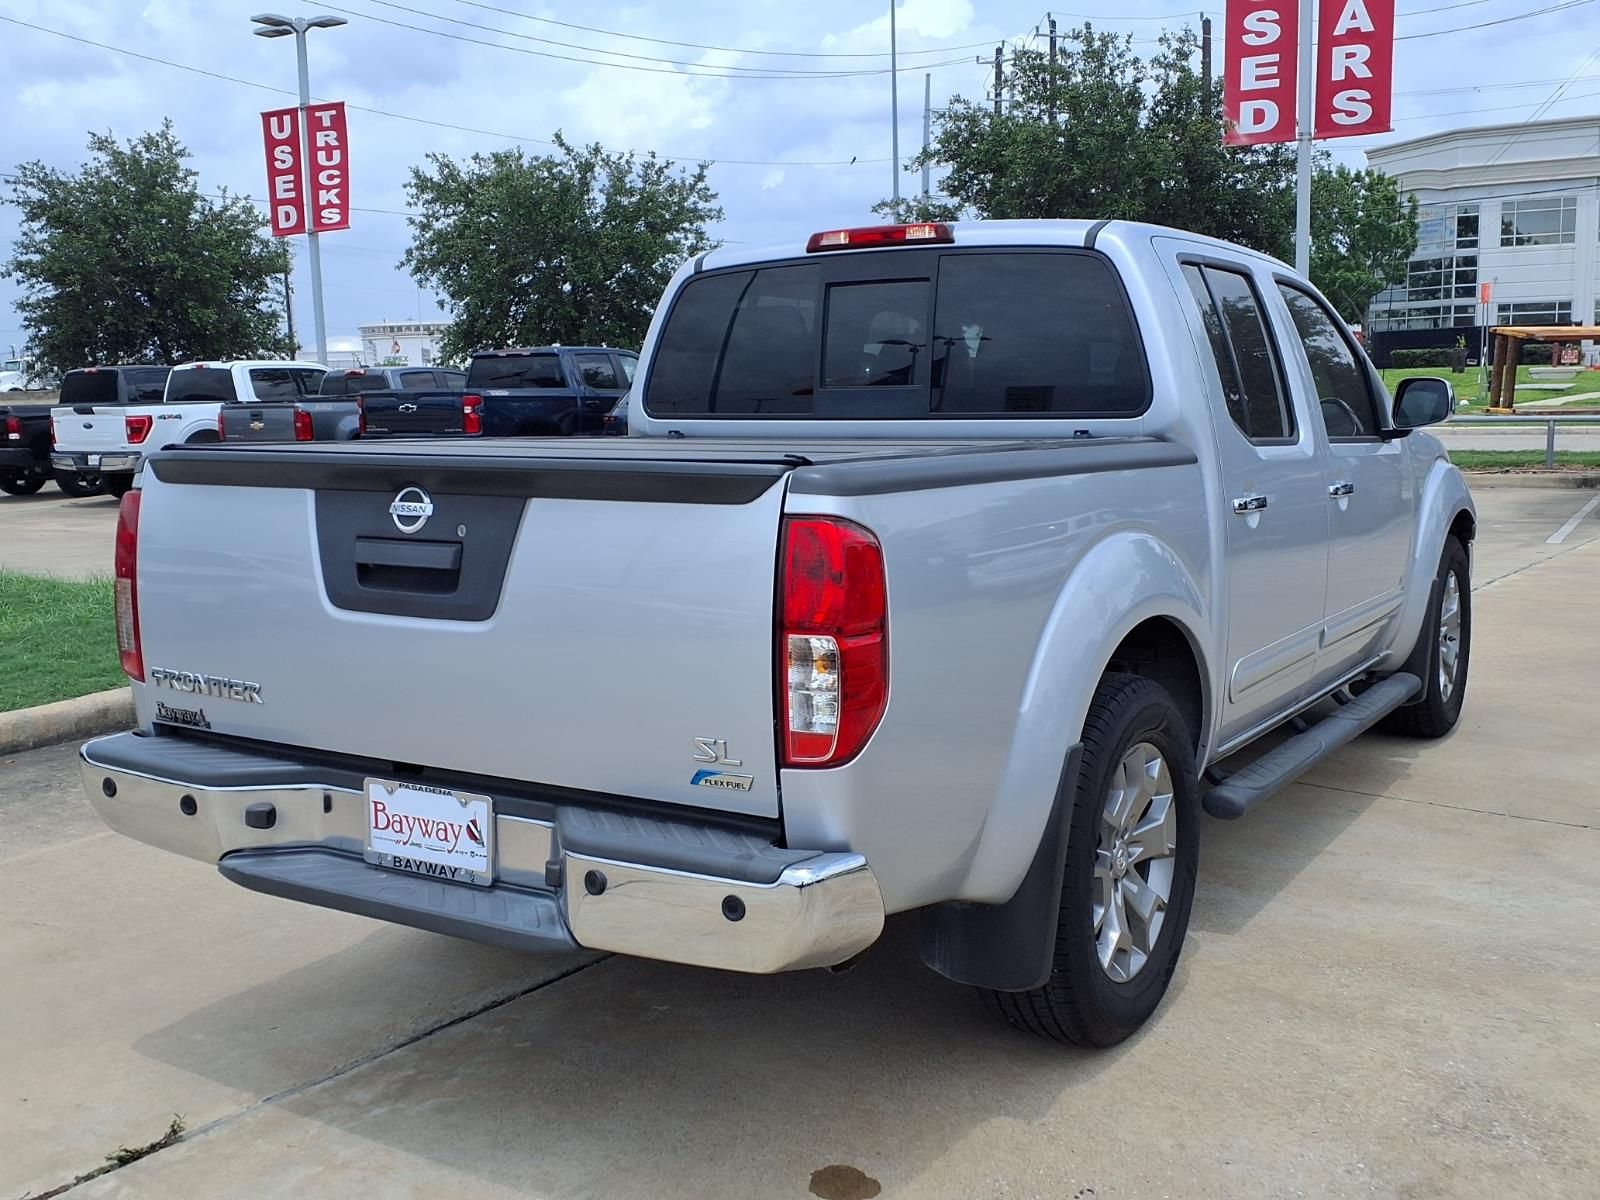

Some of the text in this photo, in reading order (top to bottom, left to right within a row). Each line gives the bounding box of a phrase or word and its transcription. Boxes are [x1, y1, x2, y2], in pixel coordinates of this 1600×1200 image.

[1239, 0, 1282, 135] SED
[269, 114, 298, 230] USED
[314, 109, 342, 225] TRUCKS
[392, 504, 427, 513] NISSAN
[151, 666, 264, 705] FRONTIER
[693, 736, 743, 767] SL
[398, 783, 453, 797] PASADENA
[704, 778, 747, 790] FLEX FUEL
[371, 800, 463, 855] Bayway
[393, 856, 458, 879] BAYWAY
